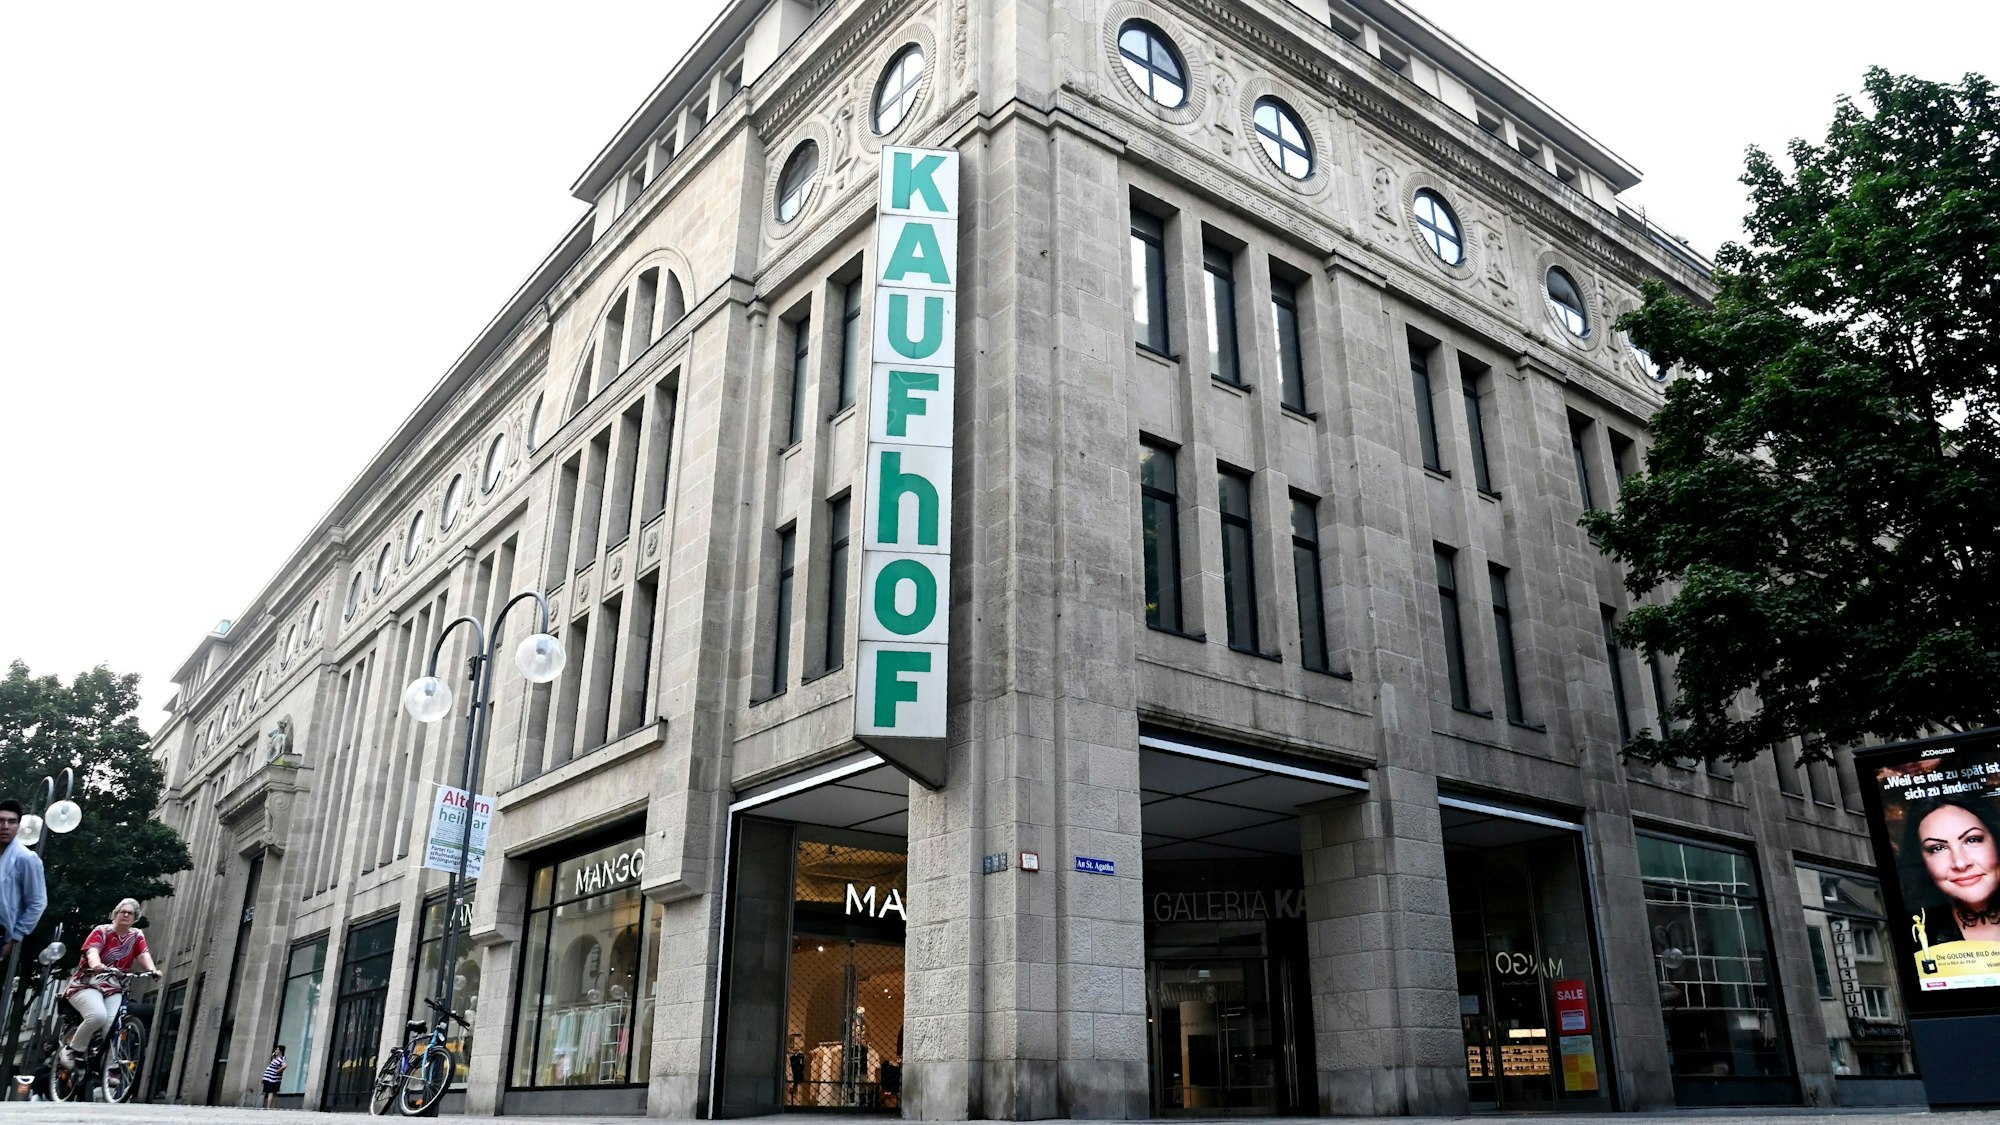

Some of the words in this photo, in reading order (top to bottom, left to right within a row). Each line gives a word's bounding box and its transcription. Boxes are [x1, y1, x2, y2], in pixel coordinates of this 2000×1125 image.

[1921, 747, 1955, 757] JCDecaux
[1913, 775, 1926, 784] es
[1927, 771, 1944, 782] nie
[1946, 770, 1958, 779] zu
[1961, 764, 1984, 779] spät
[1985, 762, 2000, 774] ist
[1904, 787, 1925, 800] sich
[1928, 786, 1940, 796] zu
[439, 807, 487, 830] heilar
[575, 848, 645, 895] MANGO
[1077, 860, 1085, 868] An
[1095, 862, 1114, 871] Agatha
[845, 883, 907, 921] MA
[1153, 890, 1270, 922] GALERIA
[1976, 950, 1989, 958] BILD
[1557, 989, 1584, 1001] SALE
